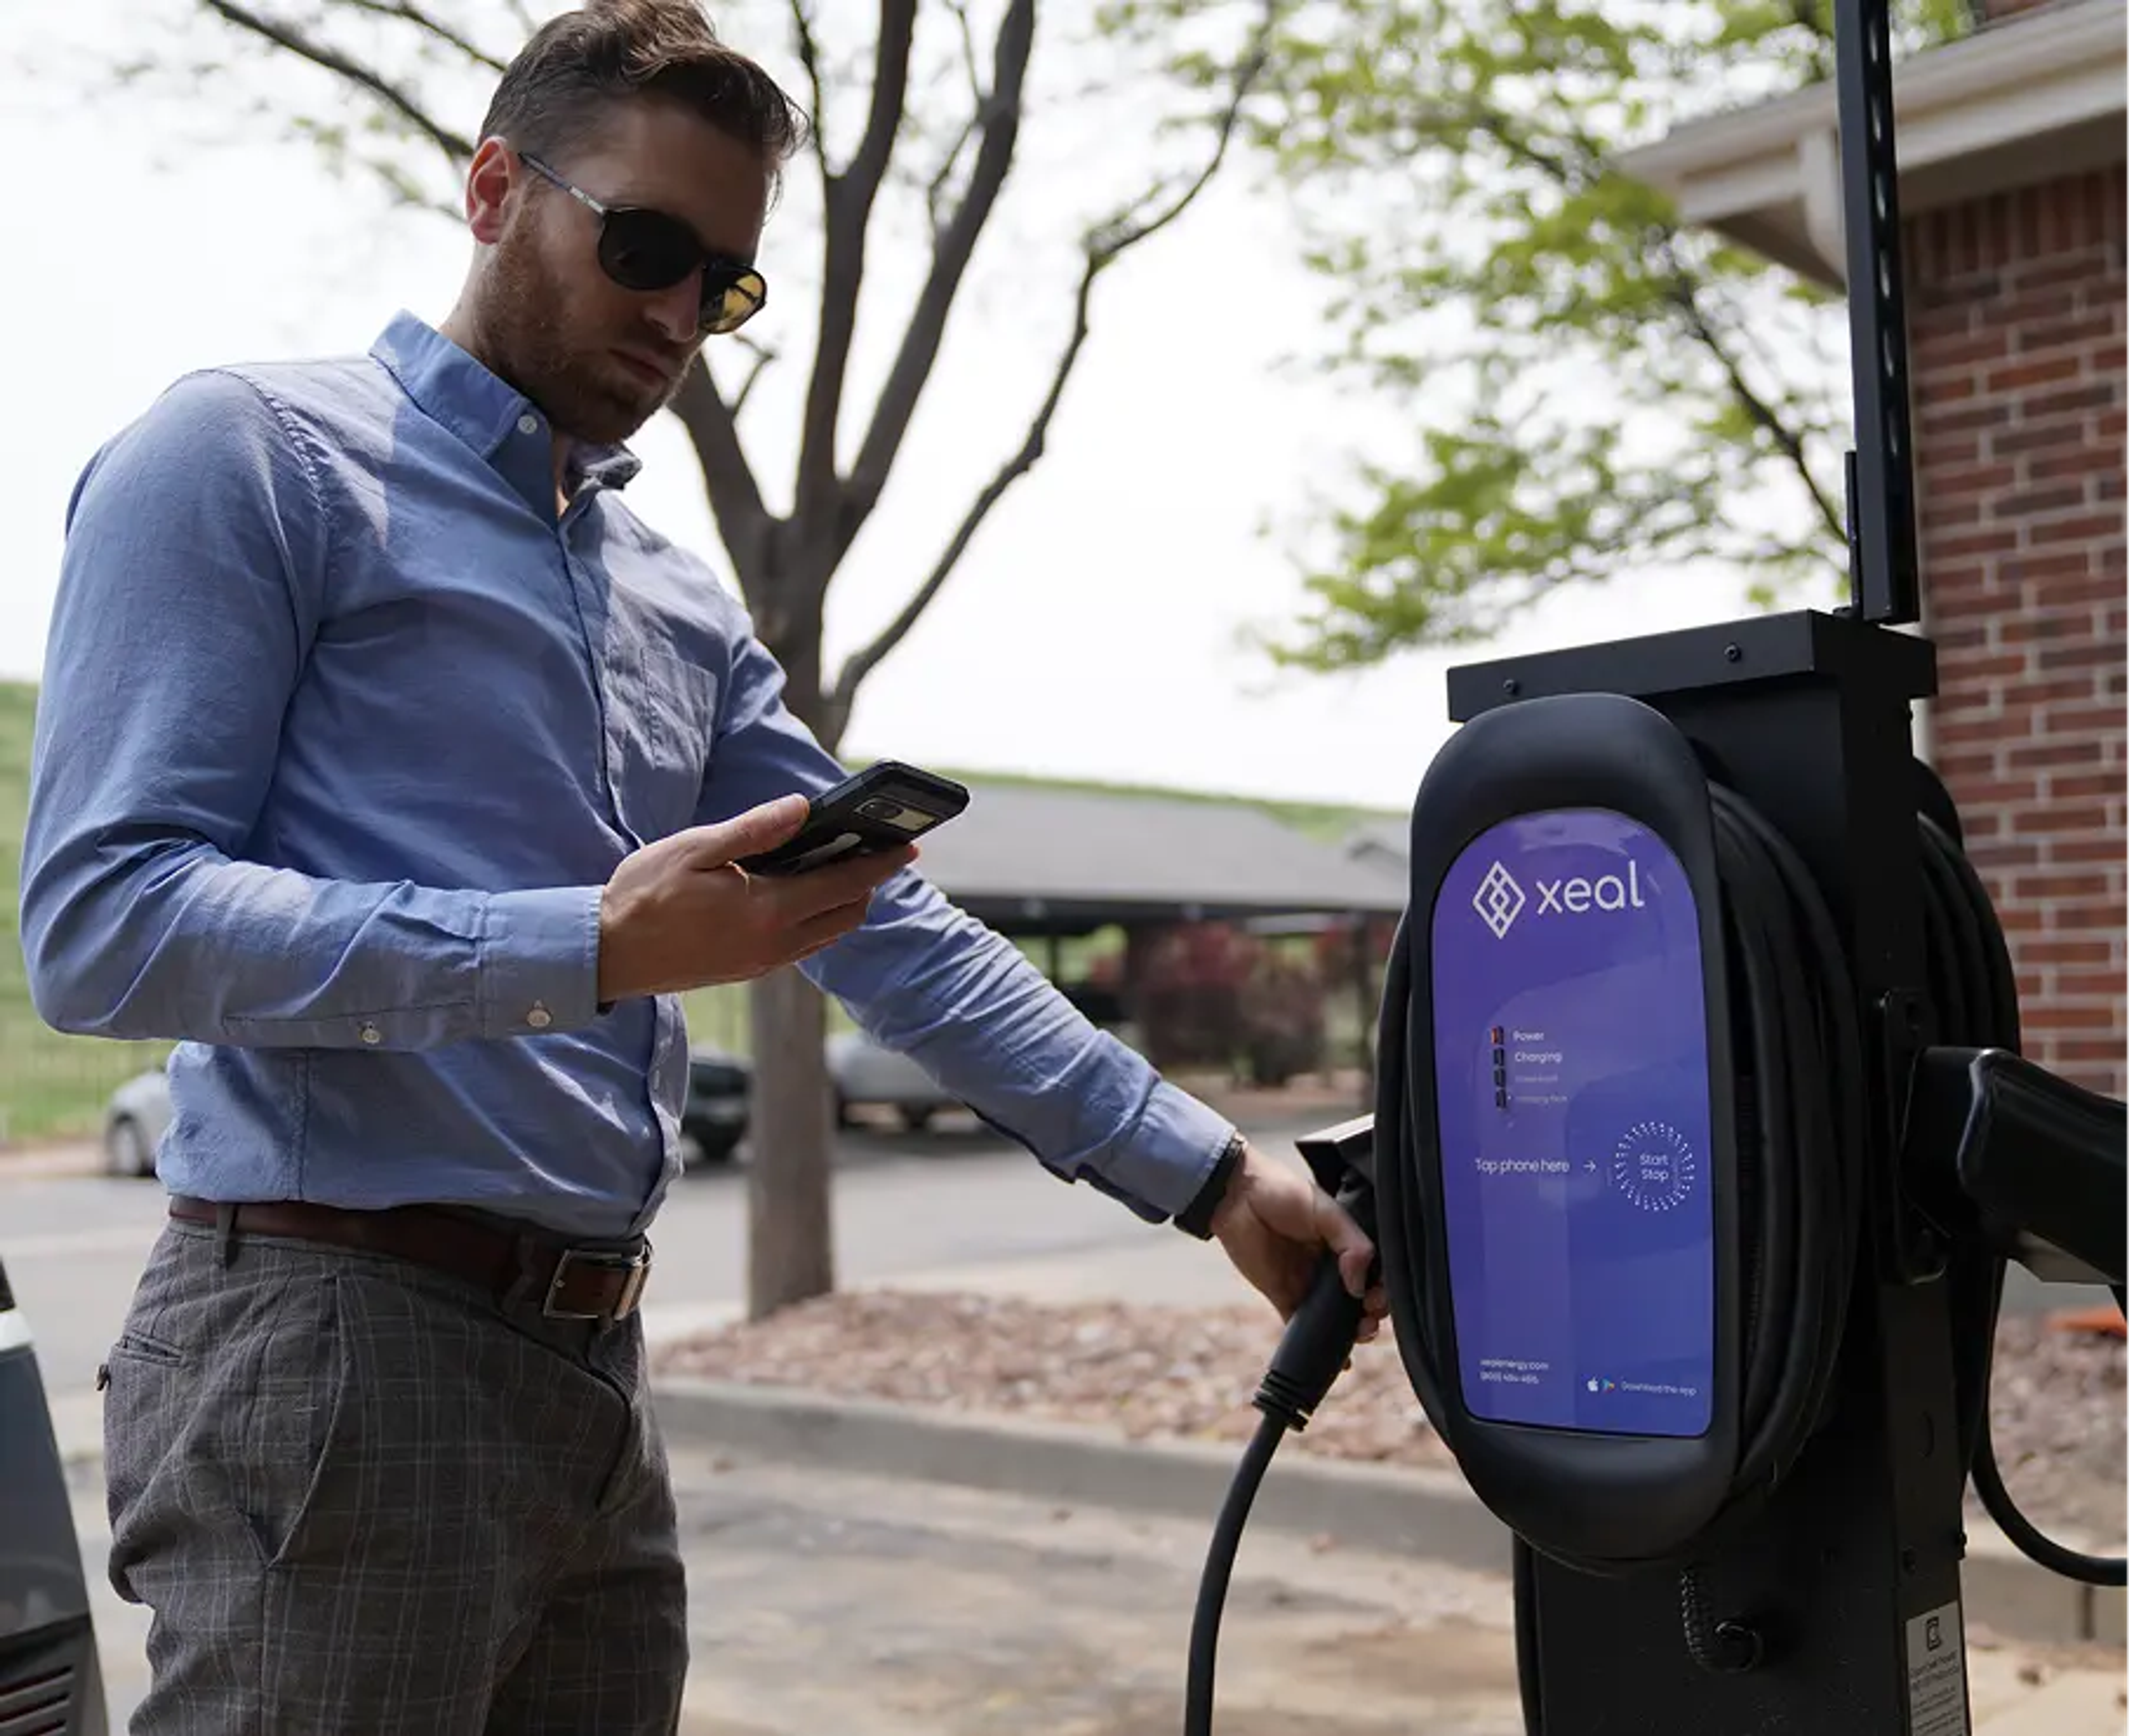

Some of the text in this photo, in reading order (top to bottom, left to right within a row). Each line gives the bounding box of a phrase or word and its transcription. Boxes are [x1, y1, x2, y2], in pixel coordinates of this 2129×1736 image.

[1536, 859, 1645, 915] xeal
[1513, 1031, 1544, 1041] Power
[1514, 1051, 1563, 1064] Charging
[1639, 1153, 1669, 1165] Start
[1474, 1158, 1570, 1175] Tap phone here
[1641, 1168, 1669, 1183] Stop
